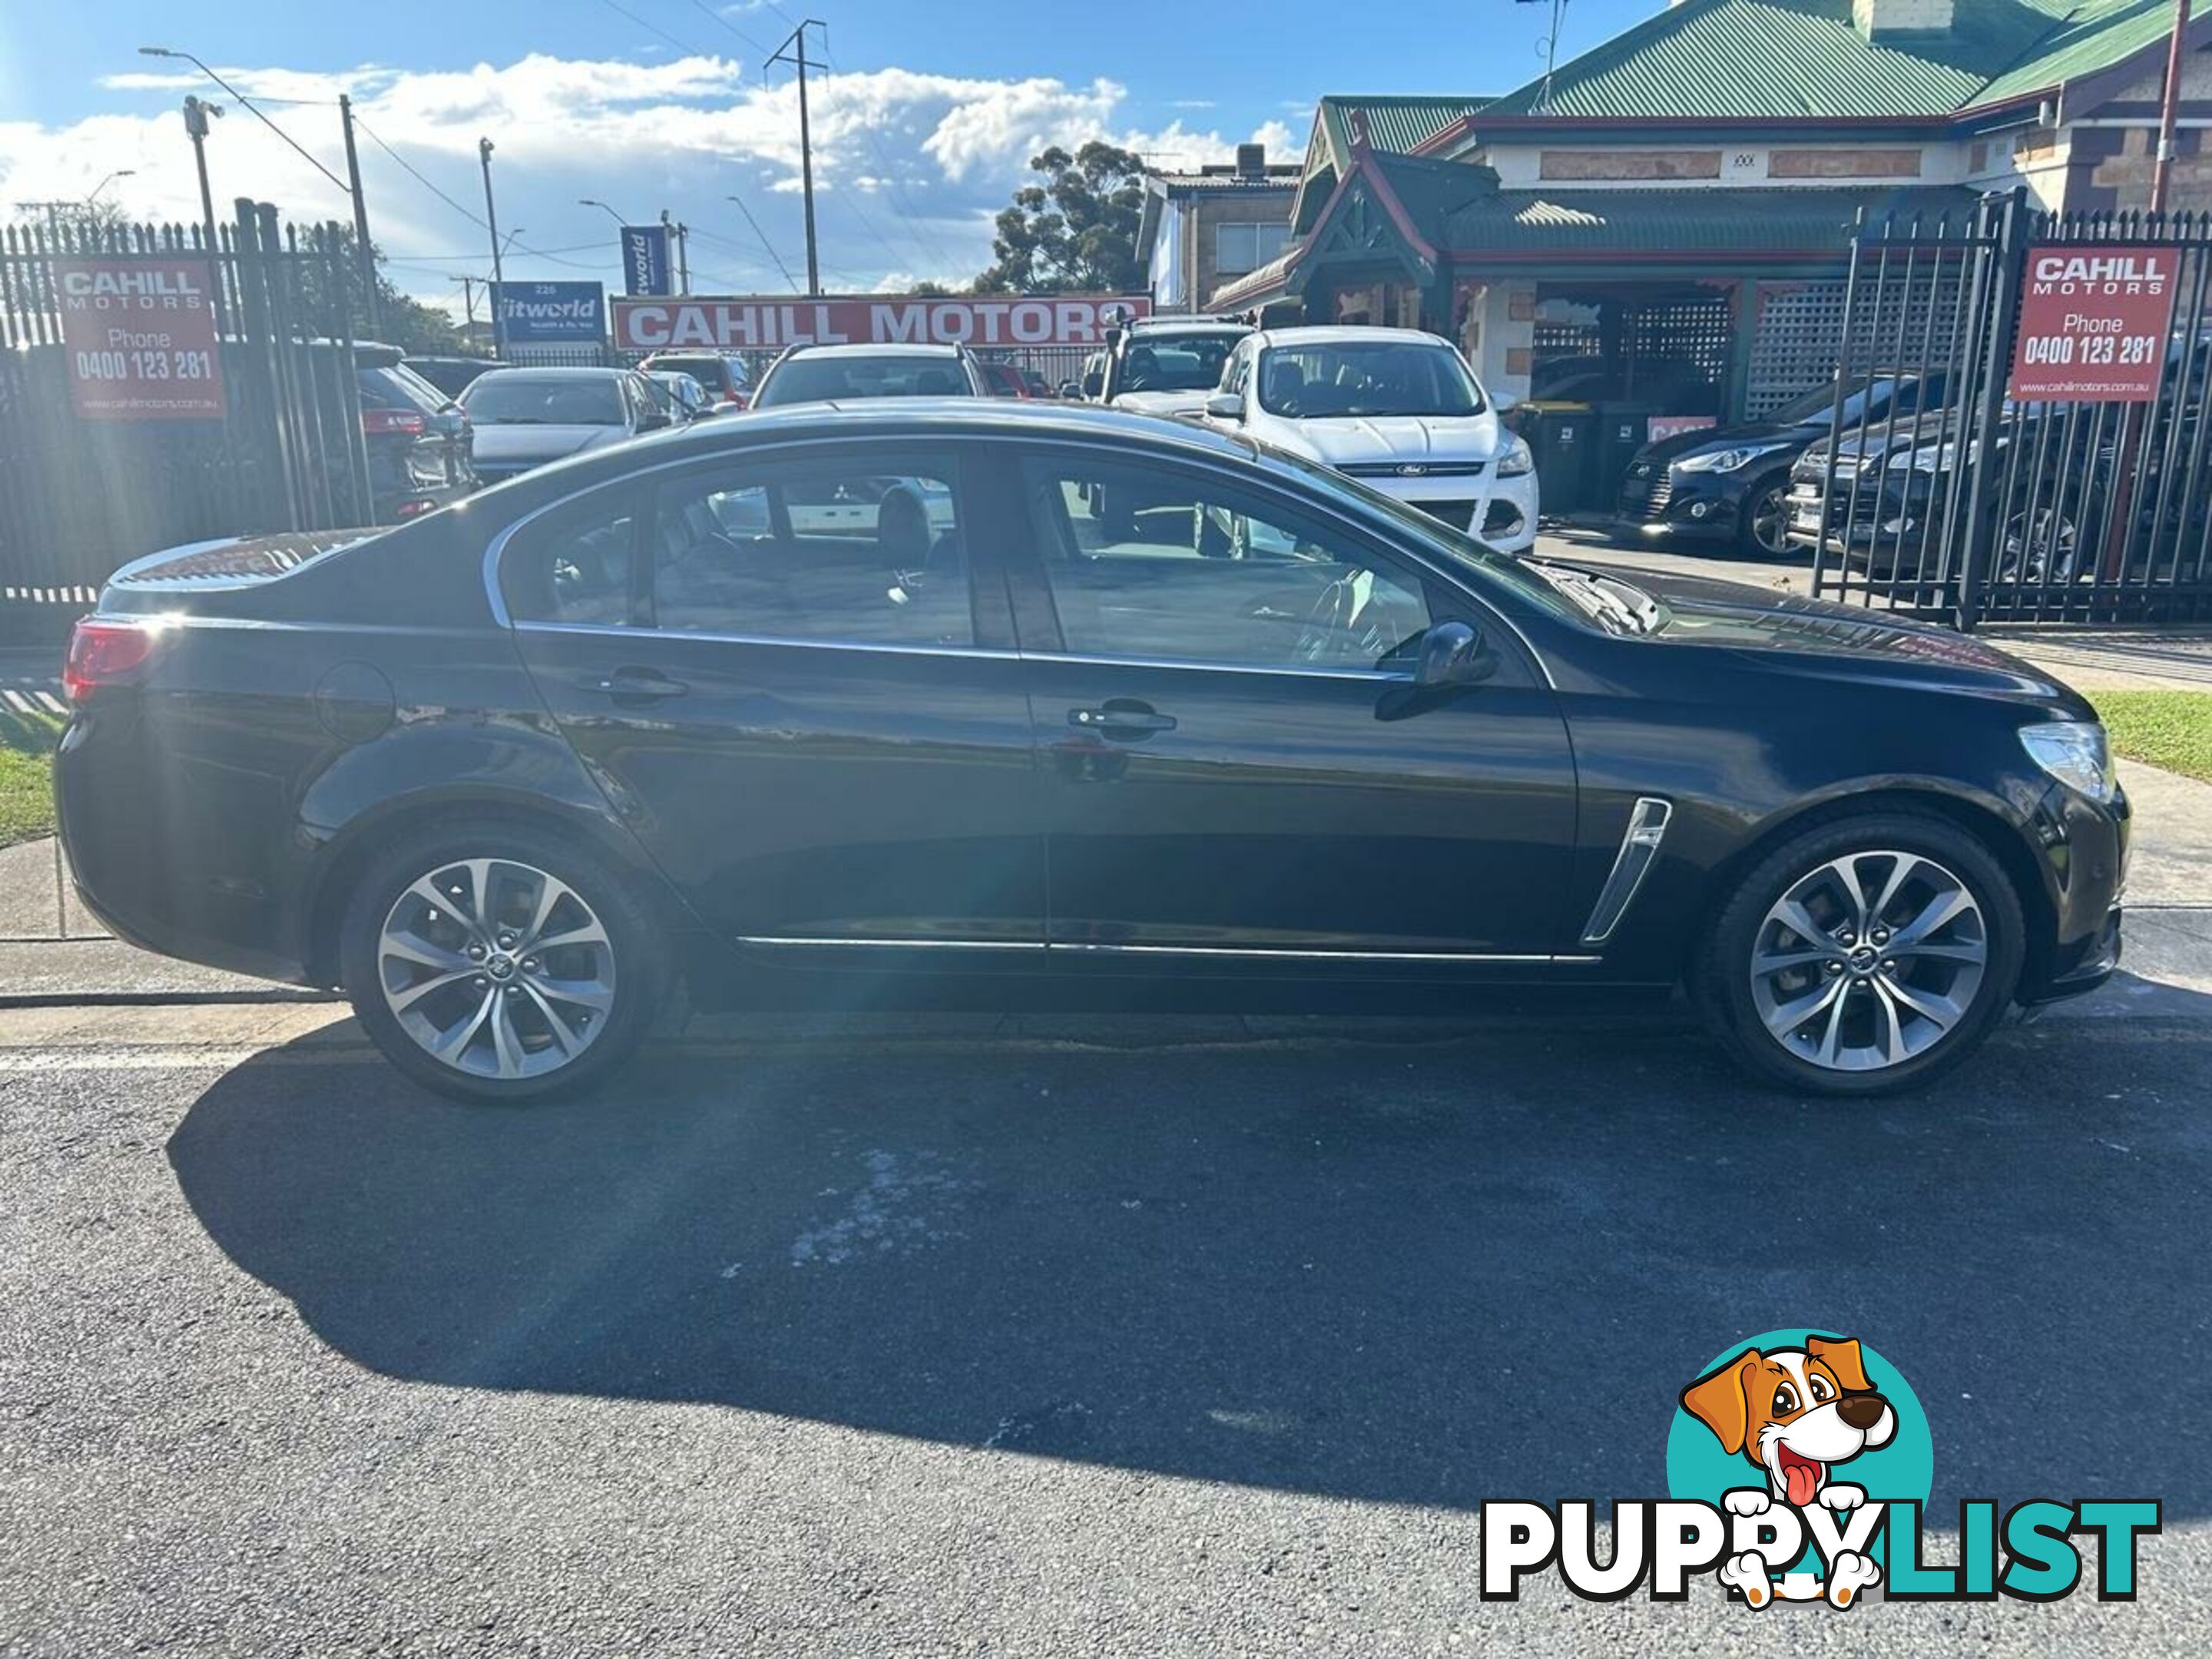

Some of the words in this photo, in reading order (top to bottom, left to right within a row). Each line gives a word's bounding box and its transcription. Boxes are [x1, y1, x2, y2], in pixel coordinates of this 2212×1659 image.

[2035, 257, 2166, 281] CAHILL
[64, 272, 201, 295] CAHILL
[2033, 282, 2163, 295] MOTORS
[67, 296, 200, 310] MOTORS
[628, 305, 848, 346] CAHILL
[2063, 313, 2124, 333] Phone
[108, 329, 171, 348] Phone
[2024, 336, 2074, 364] 0400
[2079, 336, 2114, 364] 123
[2118, 336, 2156, 364] 281
[77, 351, 128, 379] 0400
[131, 351, 170, 379] 123
[175, 351, 212, 379] 281
[2019, 381, 2150, 393] www.cahillmotors.com.au
